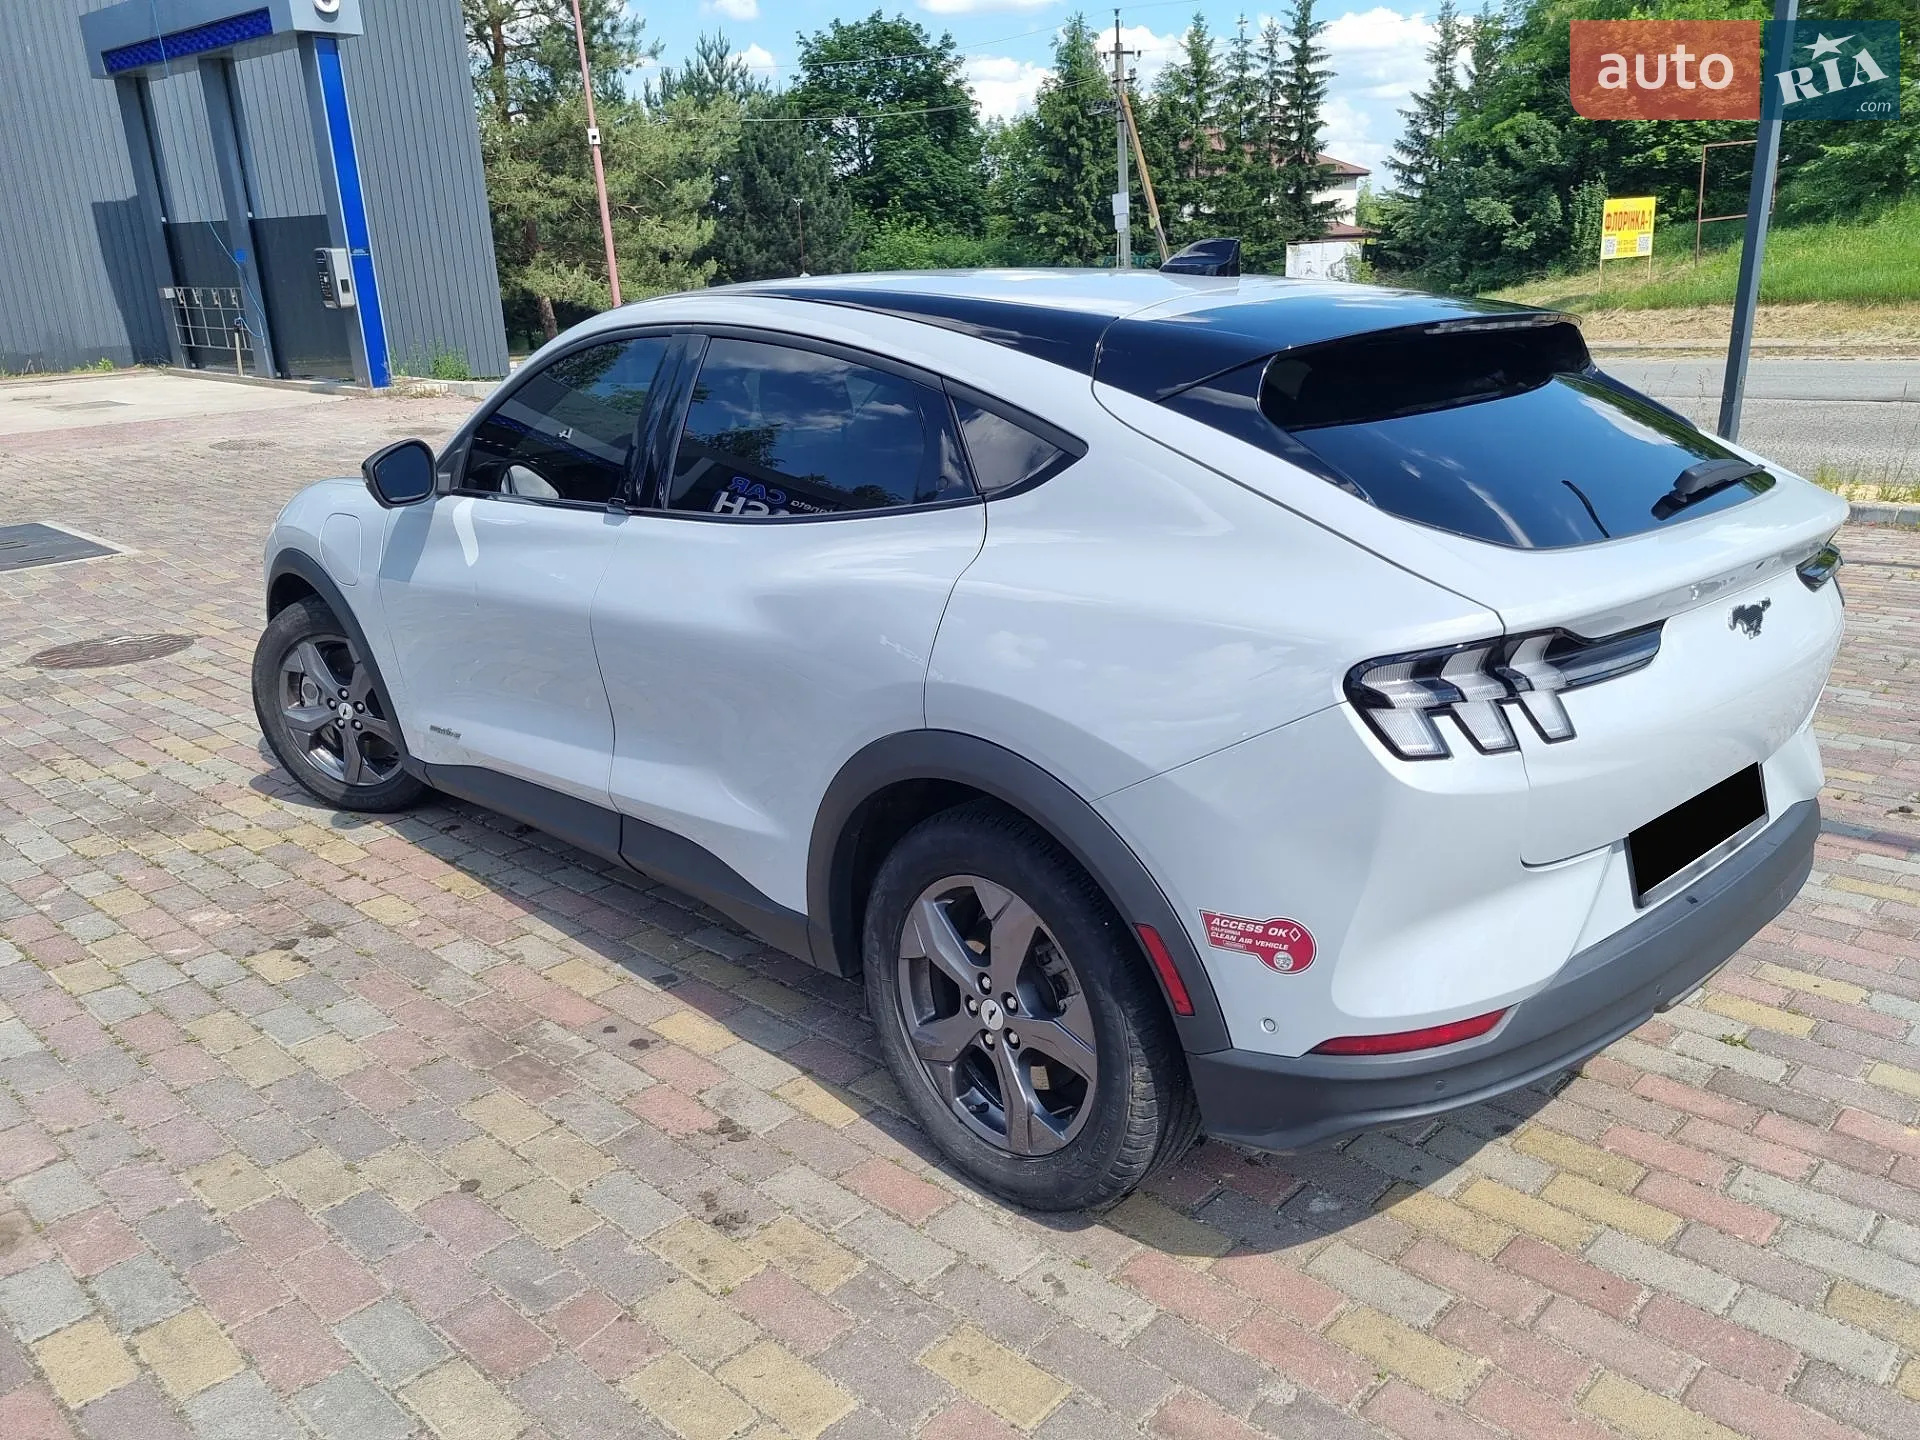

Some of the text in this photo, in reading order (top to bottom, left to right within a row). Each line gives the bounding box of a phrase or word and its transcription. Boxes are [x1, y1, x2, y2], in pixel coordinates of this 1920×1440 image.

[1211, 918, 1289, 938] ACCESS OK
[1210, 931, 1237, 941] CLEAN
[1238, 937, 1254, 945] AIR
[1255, 939, 1289, 951] VEHICLE
